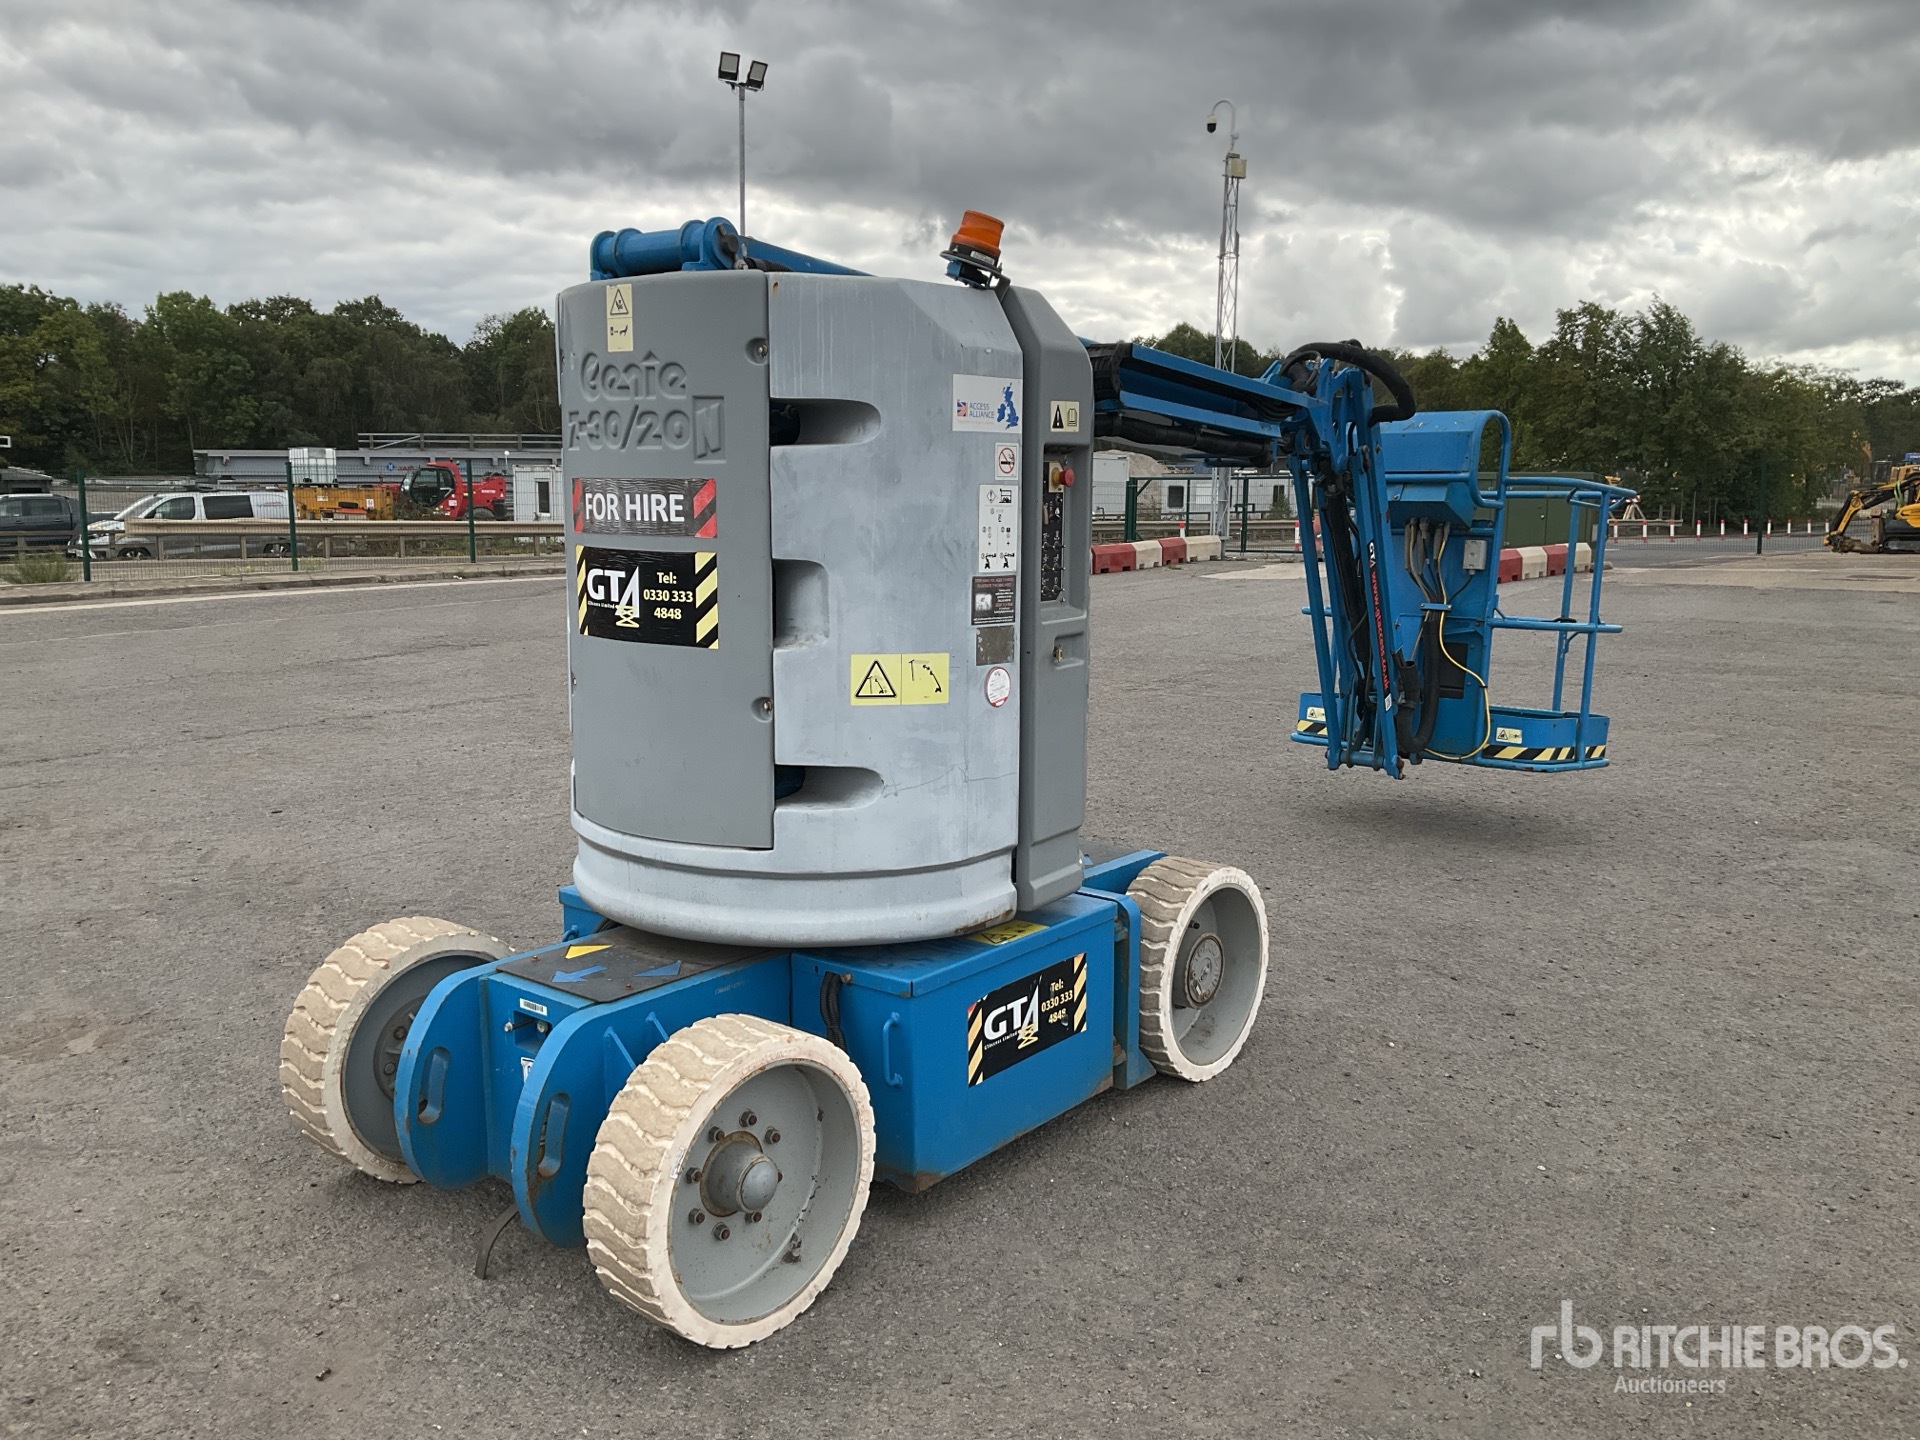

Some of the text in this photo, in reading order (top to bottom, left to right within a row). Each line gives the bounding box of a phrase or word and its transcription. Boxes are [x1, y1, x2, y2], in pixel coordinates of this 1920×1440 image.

[581, 351, 687, 401] Genie
[969, 402, 990, 411] ACCESS
[969, 410, 995, 419] ALLIANCE
[585, 493, 685, 522] FOR HIRE
[656, 571, 677, 585] Tel:
[587, 565, 640, 618] GTA
[643, 589, 694, 603] 0330 333
[653, 607, 682, 620] 4848
[1050, 979, 1063, 991] Tel:
[1041, 990, 1073, 1012] 0330 333
[984, 985, 1039, 1040] GTA
